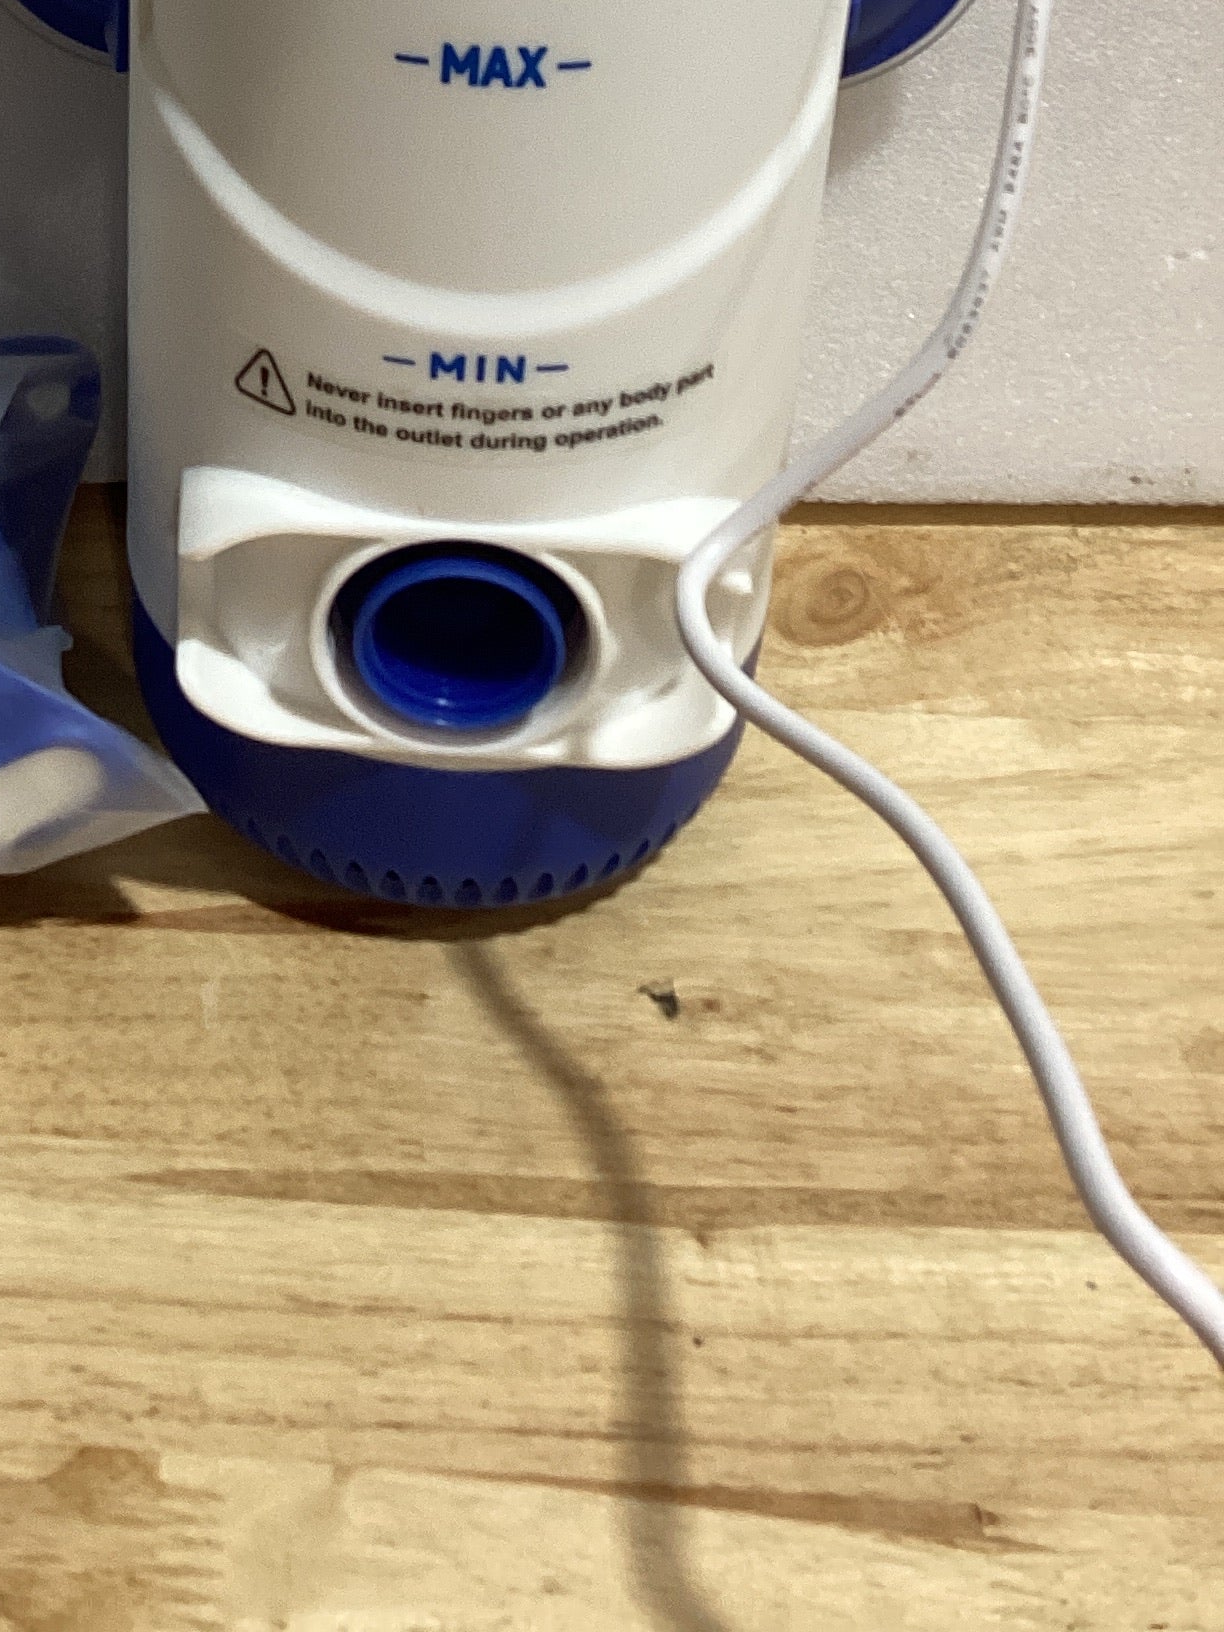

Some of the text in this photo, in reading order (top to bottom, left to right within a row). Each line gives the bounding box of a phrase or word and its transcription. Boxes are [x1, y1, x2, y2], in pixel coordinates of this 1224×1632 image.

[440, 41, 548, 89] MAX
[429, 352, 526, 383] MIN
[307, 371, 371, 404] Never
[377, 391, 444, 419] insert
[451, 402, 533, 425] fingers
[541, 404, 566, 419] or
[573, 398, 613, 416] any
[619, 381, 672, 408] body
[305, 399, 664, 452] into the outlet during operation.
